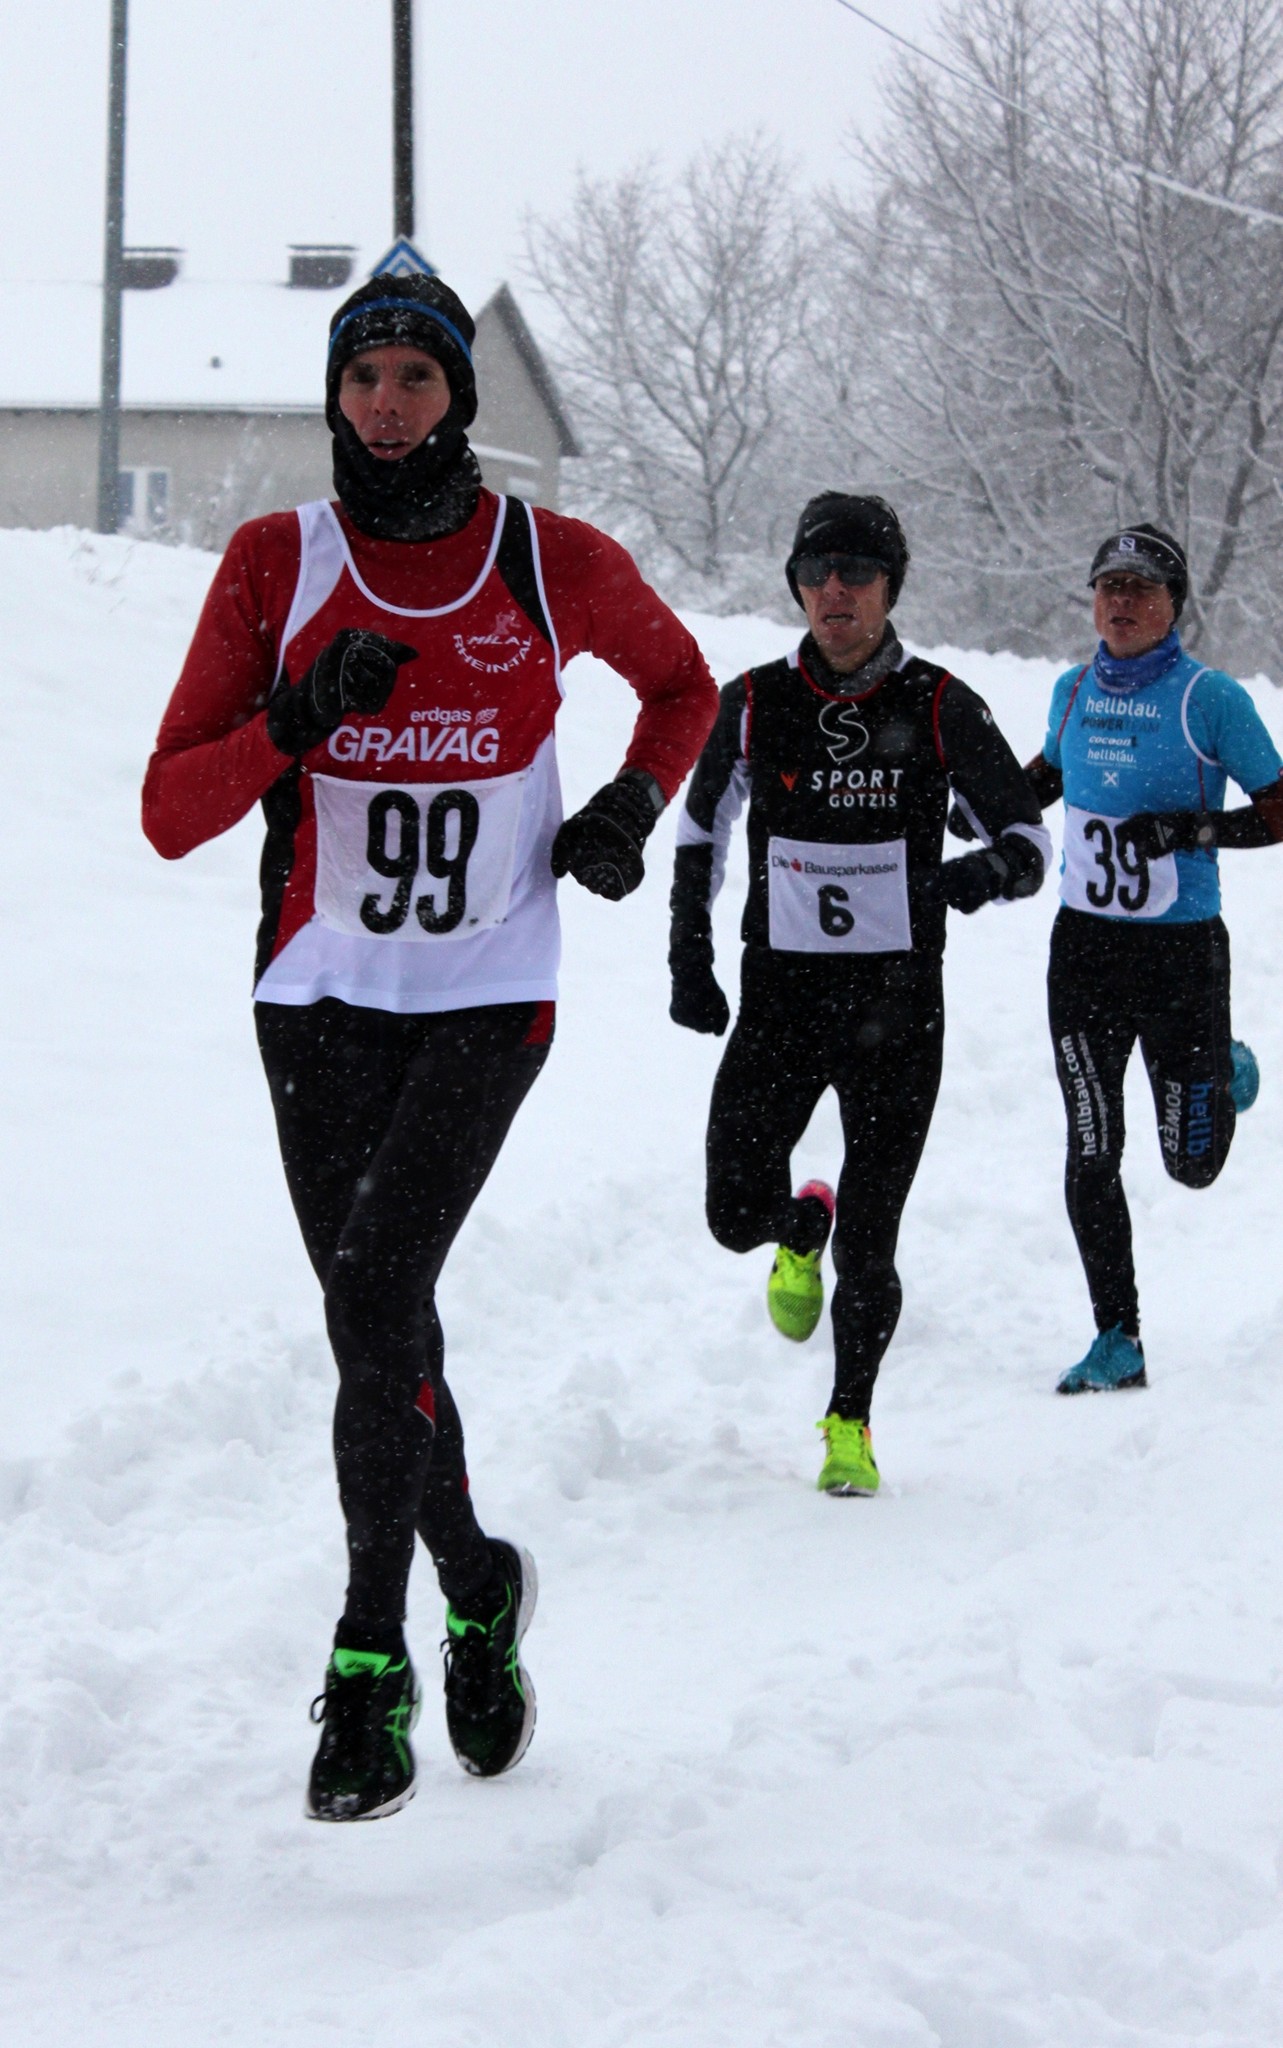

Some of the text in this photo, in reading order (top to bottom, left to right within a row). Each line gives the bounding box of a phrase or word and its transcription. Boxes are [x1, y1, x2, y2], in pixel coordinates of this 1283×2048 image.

[410, 706, 472, 725] erdgas
[327, 725, 500, 764] GRAVAG
[811, 769, 904, 792] SPORT
[359, 788, 480, 935] 99
[771, 855, 898, 877] Die Bausparkasse
[1083, 818, 1150, 912] 39
[817, 883, 855, 937] 6
[1061, 1035, 1097, 1156] hellblau.com
